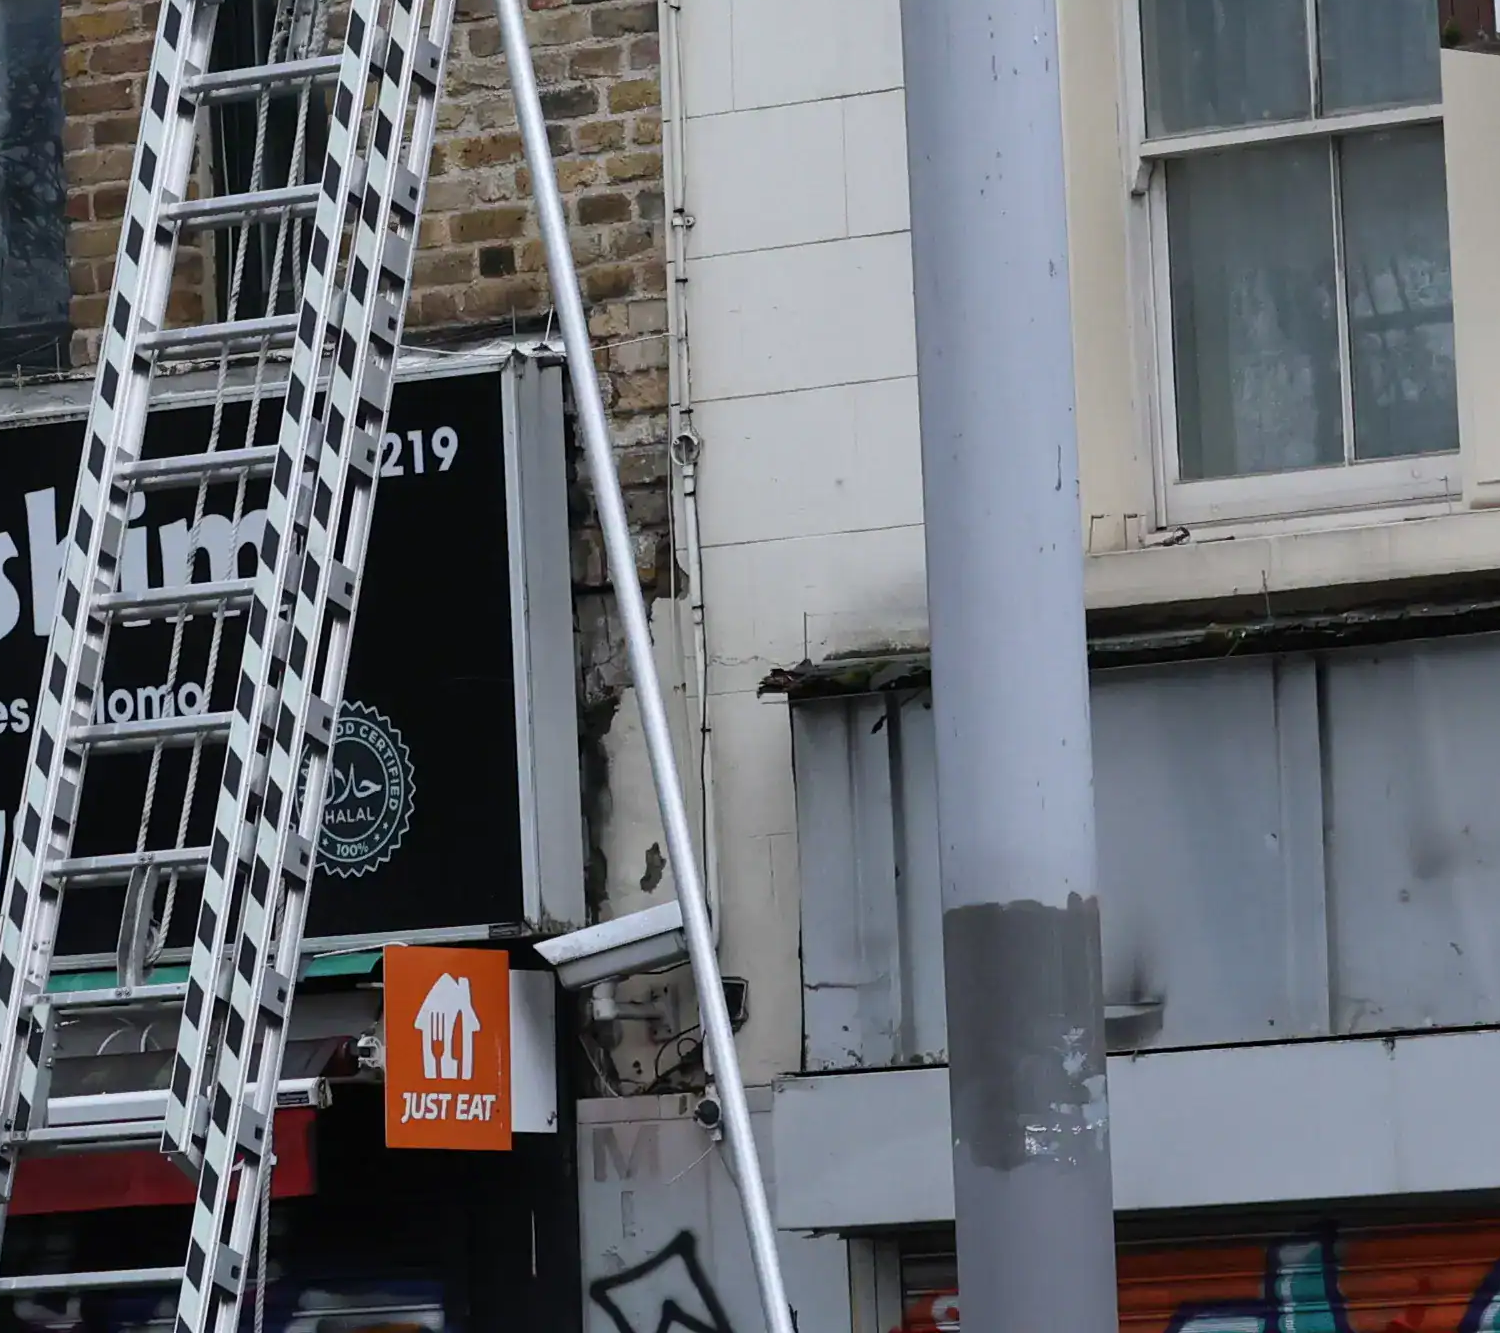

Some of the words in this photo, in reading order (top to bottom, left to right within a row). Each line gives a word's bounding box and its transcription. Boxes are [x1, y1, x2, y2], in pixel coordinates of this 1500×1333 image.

[380, 425, 459, 477] 219
[359, 724, 401, 811] CERTIFIED
[325, 807, 376, 825] HALAL
[336, 841, 370, 857] 100%
[401, 1092, 452, 1123] JUST
[455, 1093, 496, 1121] EAT
